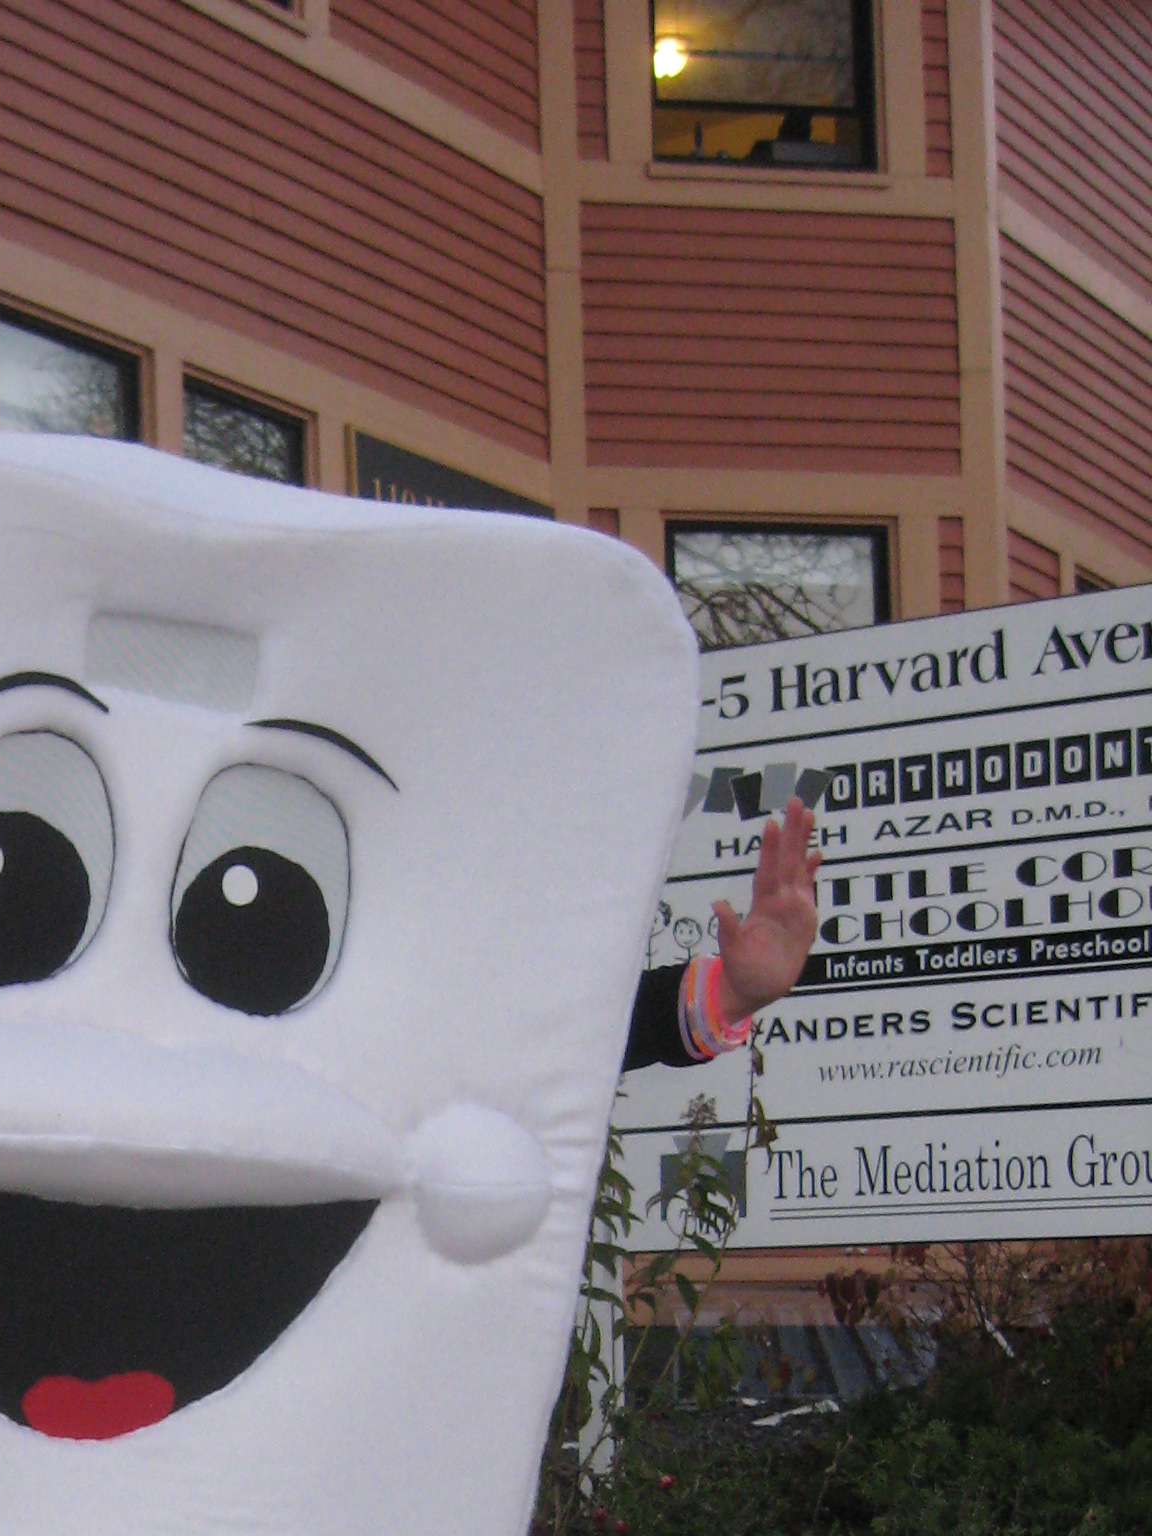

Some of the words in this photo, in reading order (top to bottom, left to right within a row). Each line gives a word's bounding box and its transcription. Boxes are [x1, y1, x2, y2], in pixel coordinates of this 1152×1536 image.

[770, 628, 1008, 712] Harvard
[874, 808, 993, 841] AZAR
[825, 954, 904, 980] Infants
[916, 944, 1018, 971] Toddlers
[1030, 930, 1149, 961] Preschool
[818, 1043, 1102, 1083] www.rascientific.com
[769, 1149, 839, 1199] The
[854, 1139, 1051, 1197] Mediation
